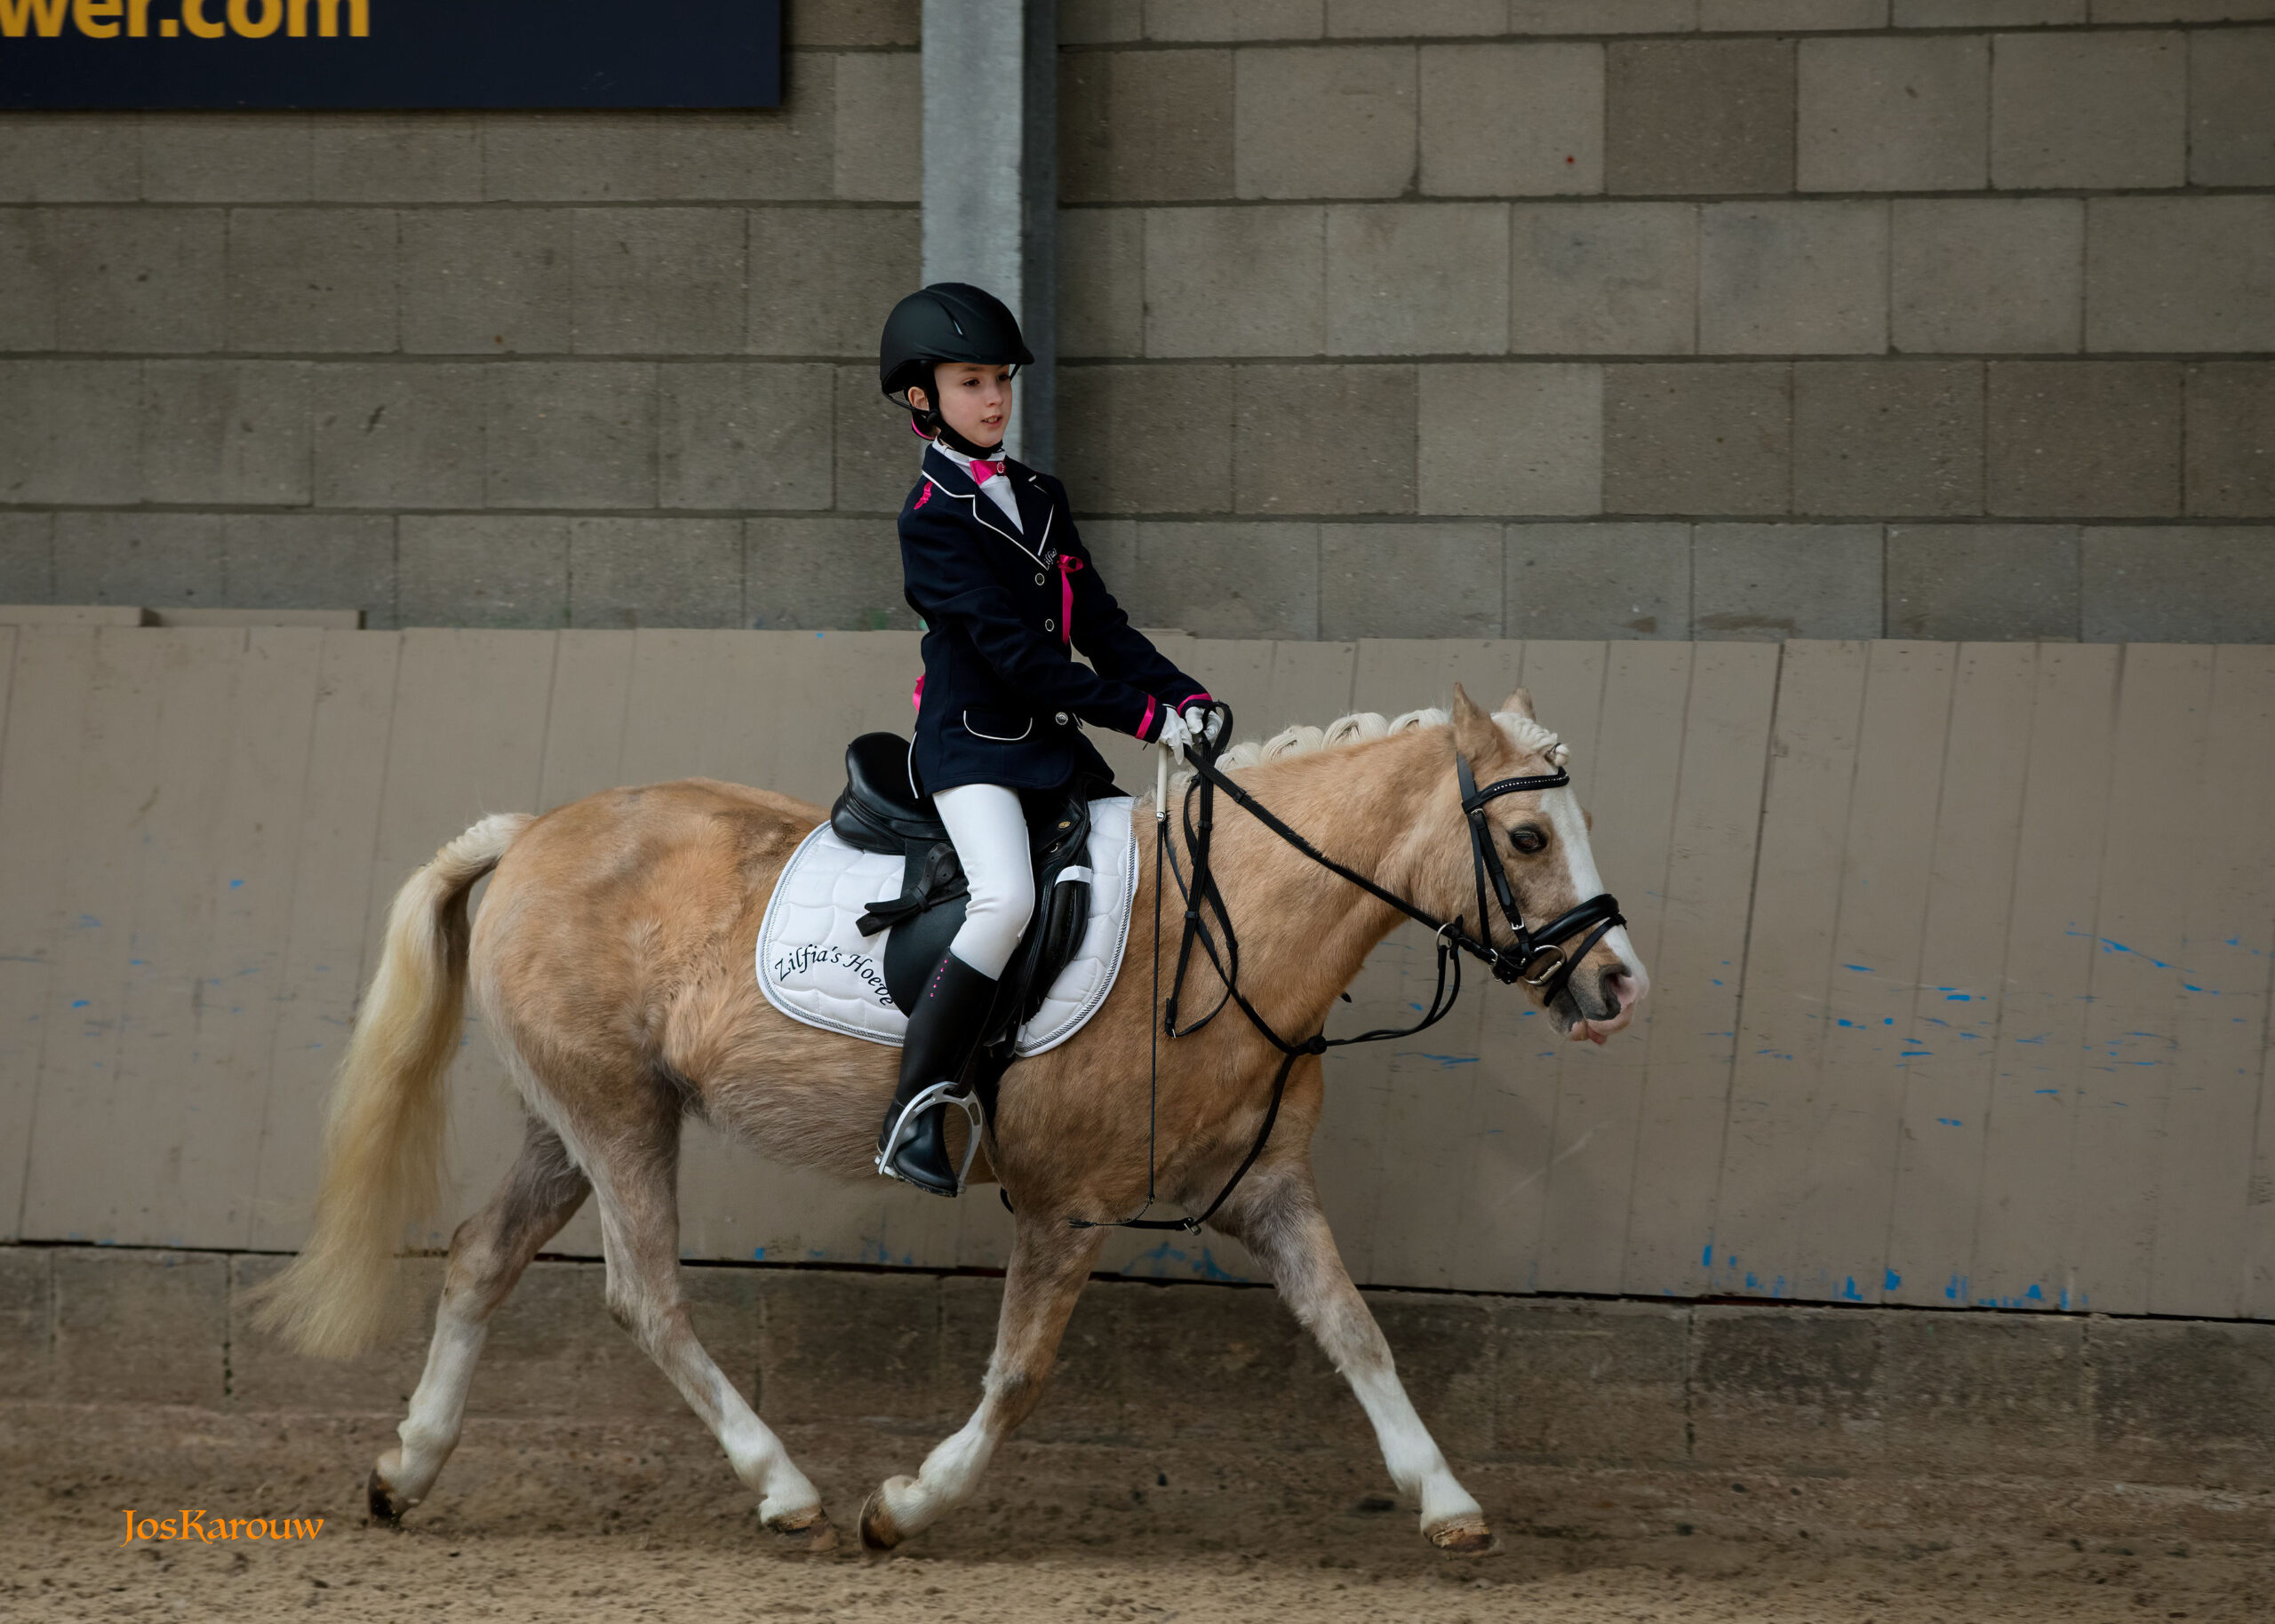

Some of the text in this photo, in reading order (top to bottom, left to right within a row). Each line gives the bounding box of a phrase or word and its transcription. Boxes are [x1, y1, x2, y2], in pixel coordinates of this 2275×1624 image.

[0, 0, 370, 38] wer.com
[774, 943, 894, 1006] Zilfia's Hoeve
